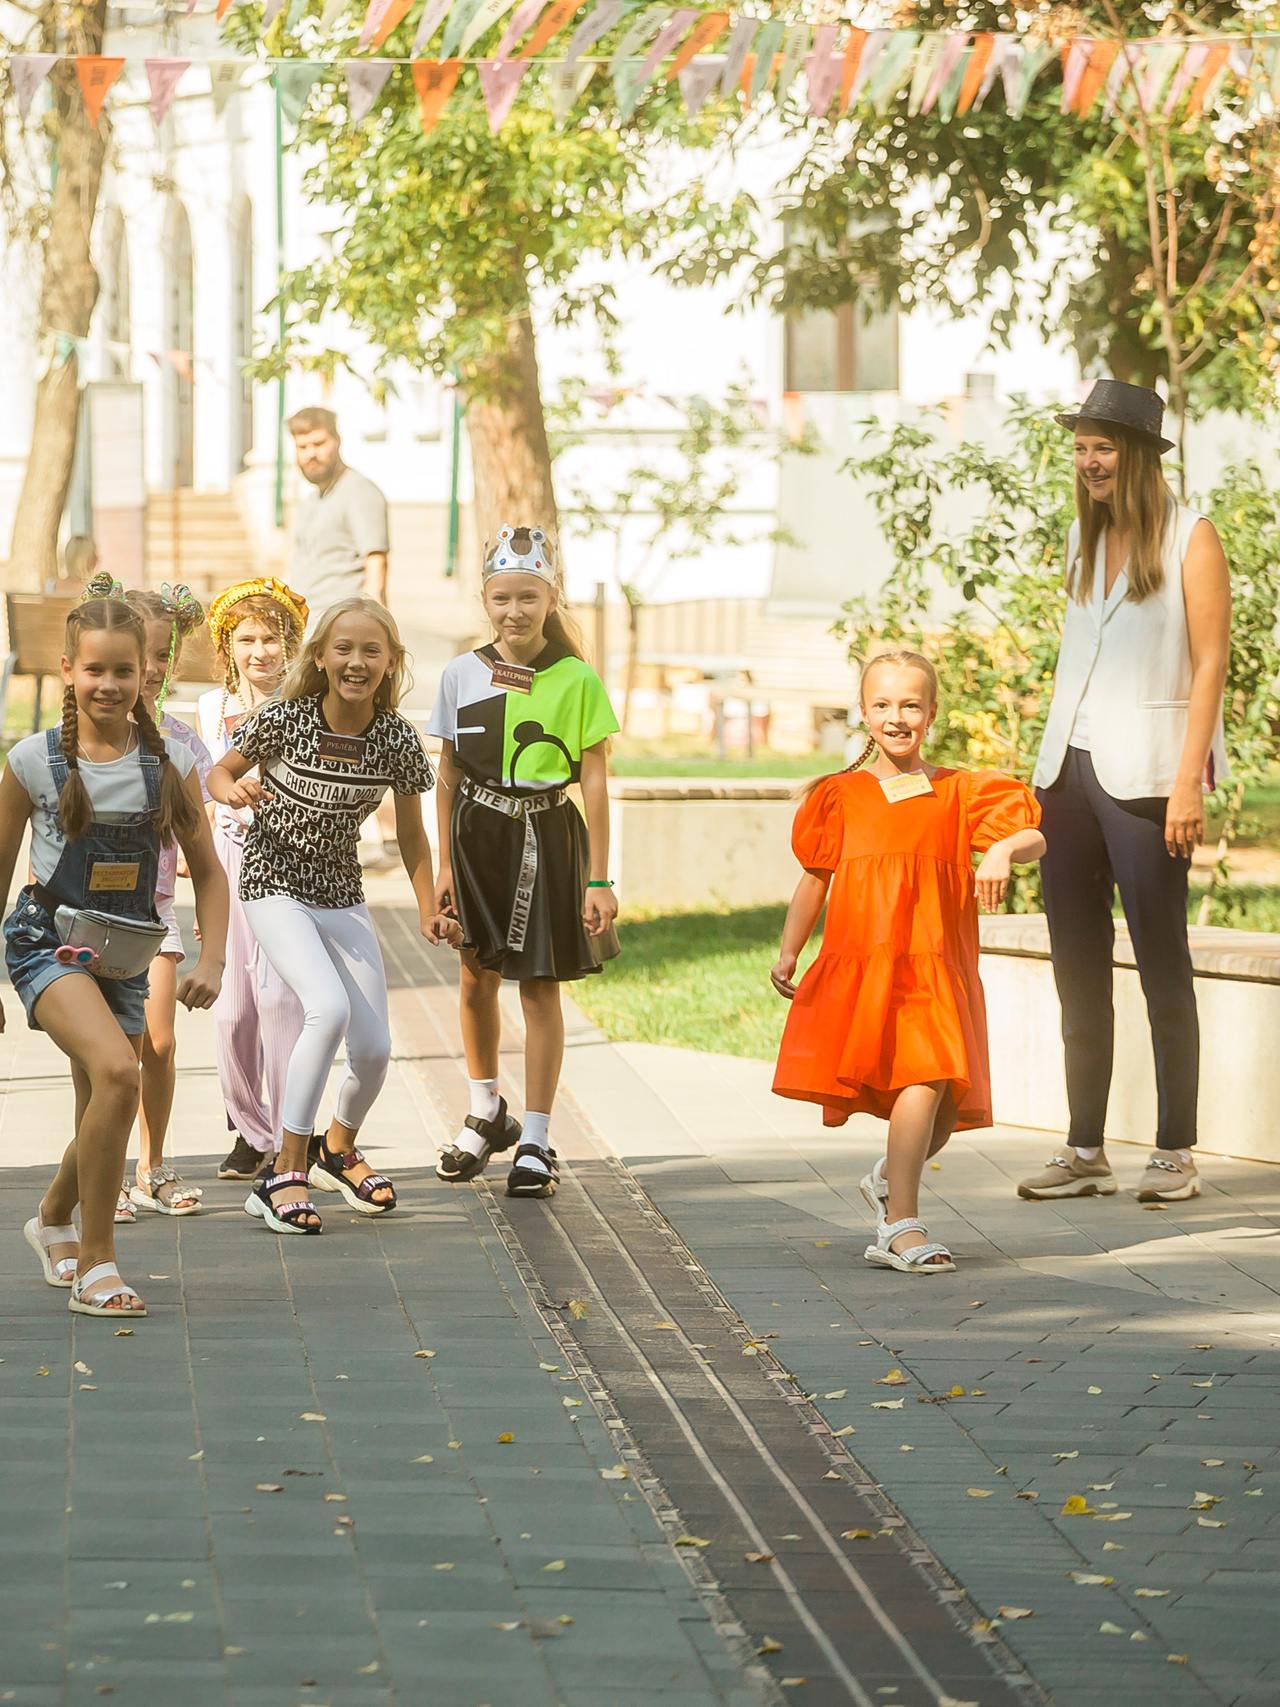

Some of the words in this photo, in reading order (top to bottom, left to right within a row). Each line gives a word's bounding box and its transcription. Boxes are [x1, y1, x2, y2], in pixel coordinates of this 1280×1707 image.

[326, 741, 358, 752] РУБЛЁВА
[285, 771, 351, 803] CHRISTIAN
[353, 788, 379, 801] DIOR
[313, 801, 344, 810] PARIS
